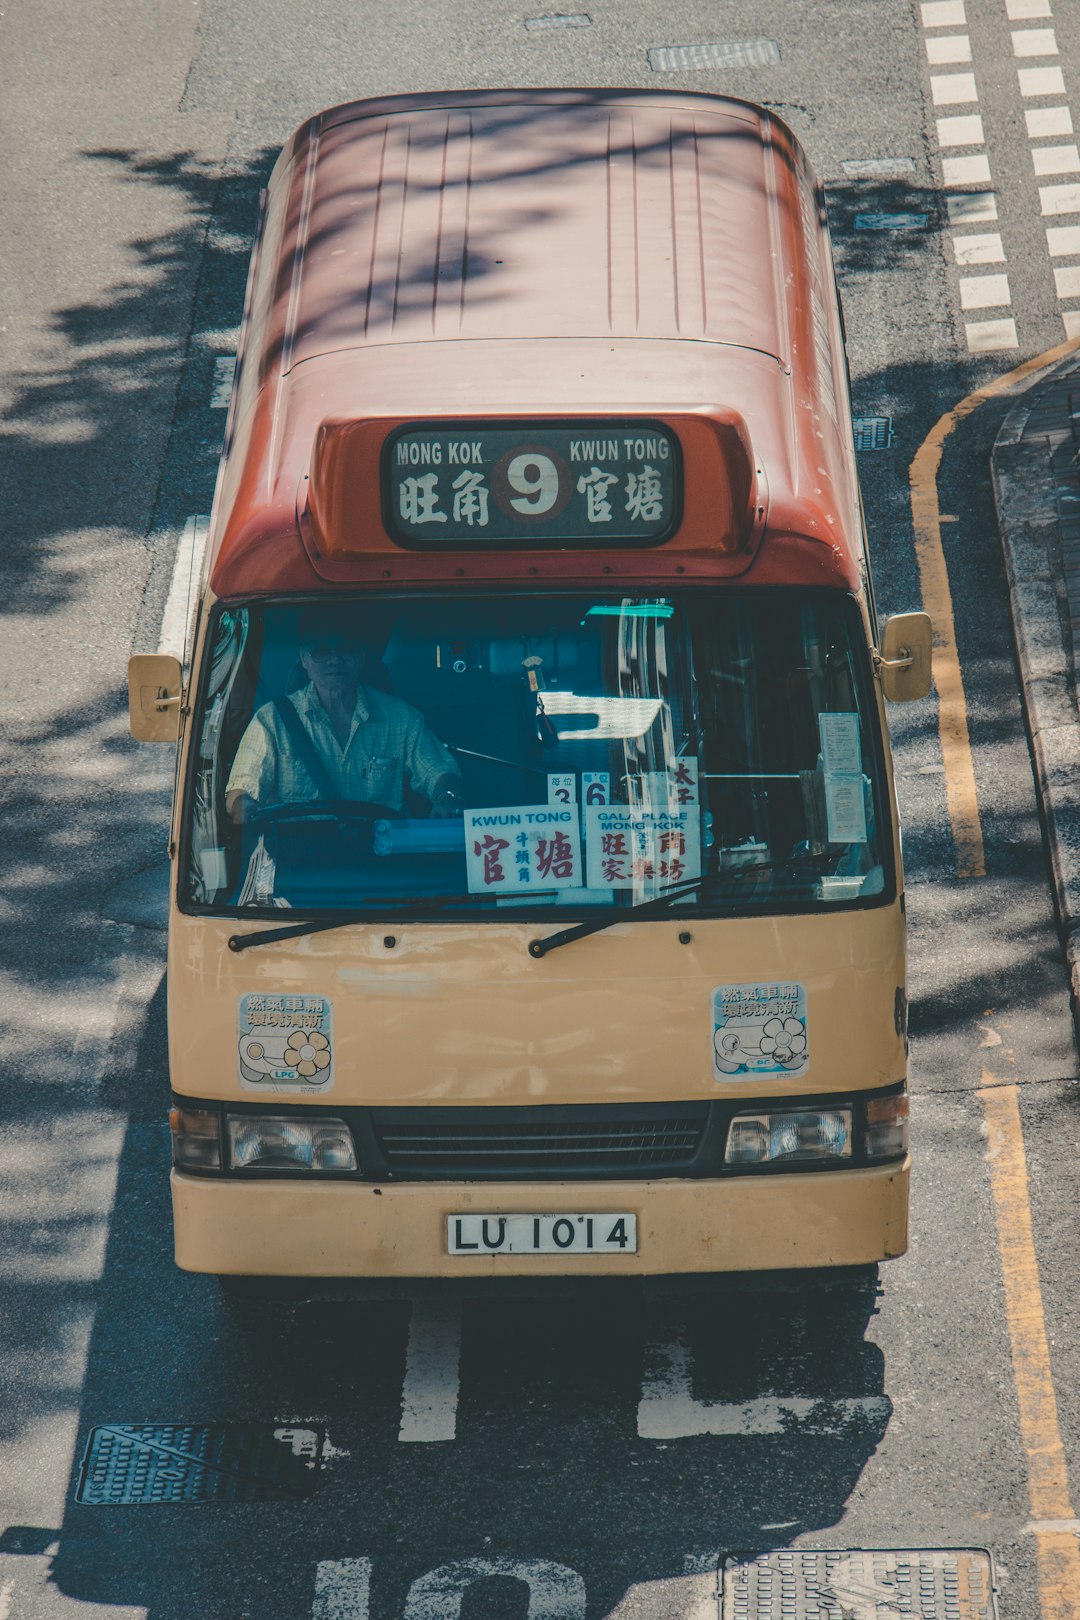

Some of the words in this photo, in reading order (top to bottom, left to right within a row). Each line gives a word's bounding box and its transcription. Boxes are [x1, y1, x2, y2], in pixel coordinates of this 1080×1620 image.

[397, 442, 442, 465] MONG
[448, 442, 483, 465] KOK
[570, 440, 618, 462] KWUN
[624, 438, 669, 460] TONG
[507, 453, 559, 515] 9
[576, 465, 664, 523] 官塘
[399, 469, 489, 527] 旺角
[586, 782, 606, 806] 6
[472, 815, 521, 827] KWUN
[525, 811, 571, 824] TONG
[598, 812, 637, 821] GALA
[641, 812, 688, 821] PLACE
[601, 822, 645, 830] MONG
[653, 821, 685, 830] KOK
[515, 831, 531, 883] 牛頭角
[275, 1071, 295, 1079] LPG
[455, 1219, 505, 1249] LU
[533, 1218, 628, 1248] 1014
